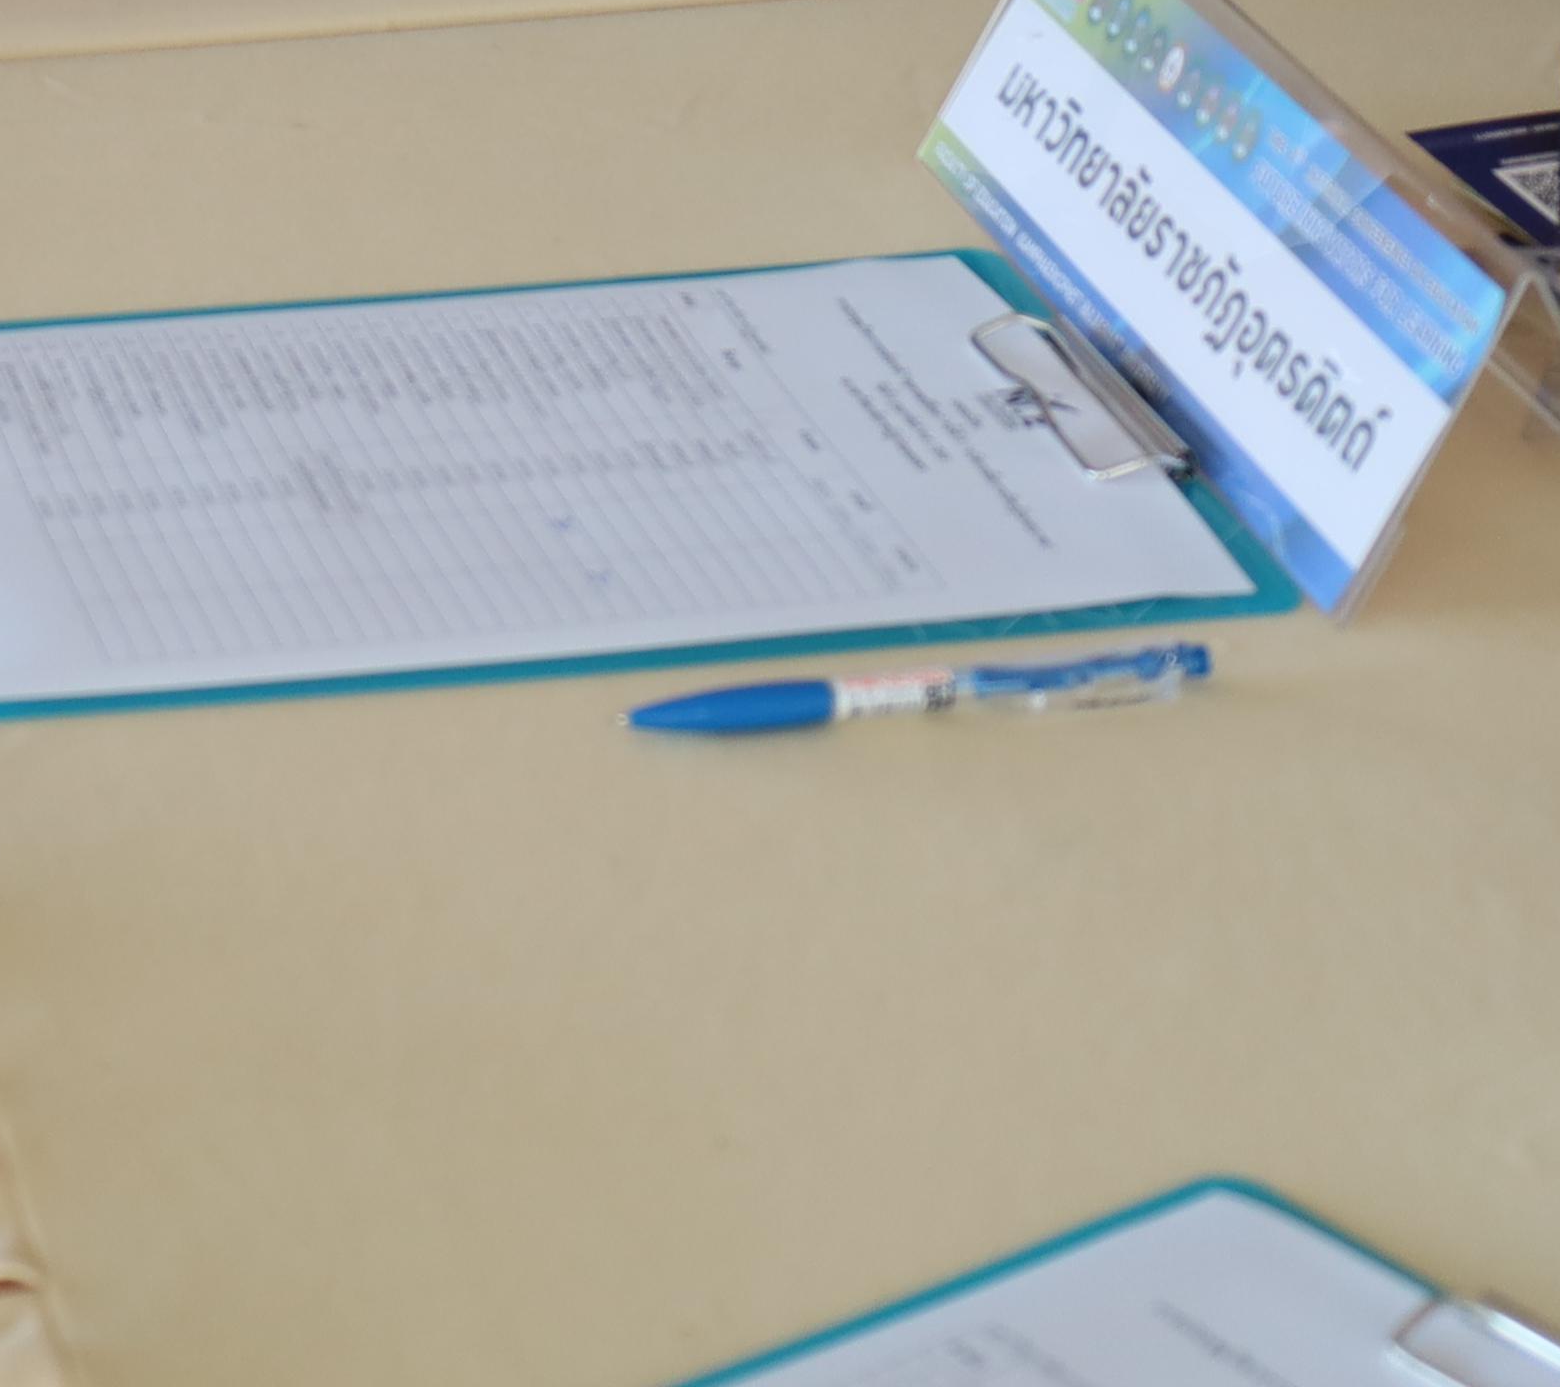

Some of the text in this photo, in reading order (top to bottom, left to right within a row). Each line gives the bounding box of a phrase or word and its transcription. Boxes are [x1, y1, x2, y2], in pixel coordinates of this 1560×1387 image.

[997, 61, 1396, 473] มหาวิทยาลัยราชภัฏอุตรดิตถ์
